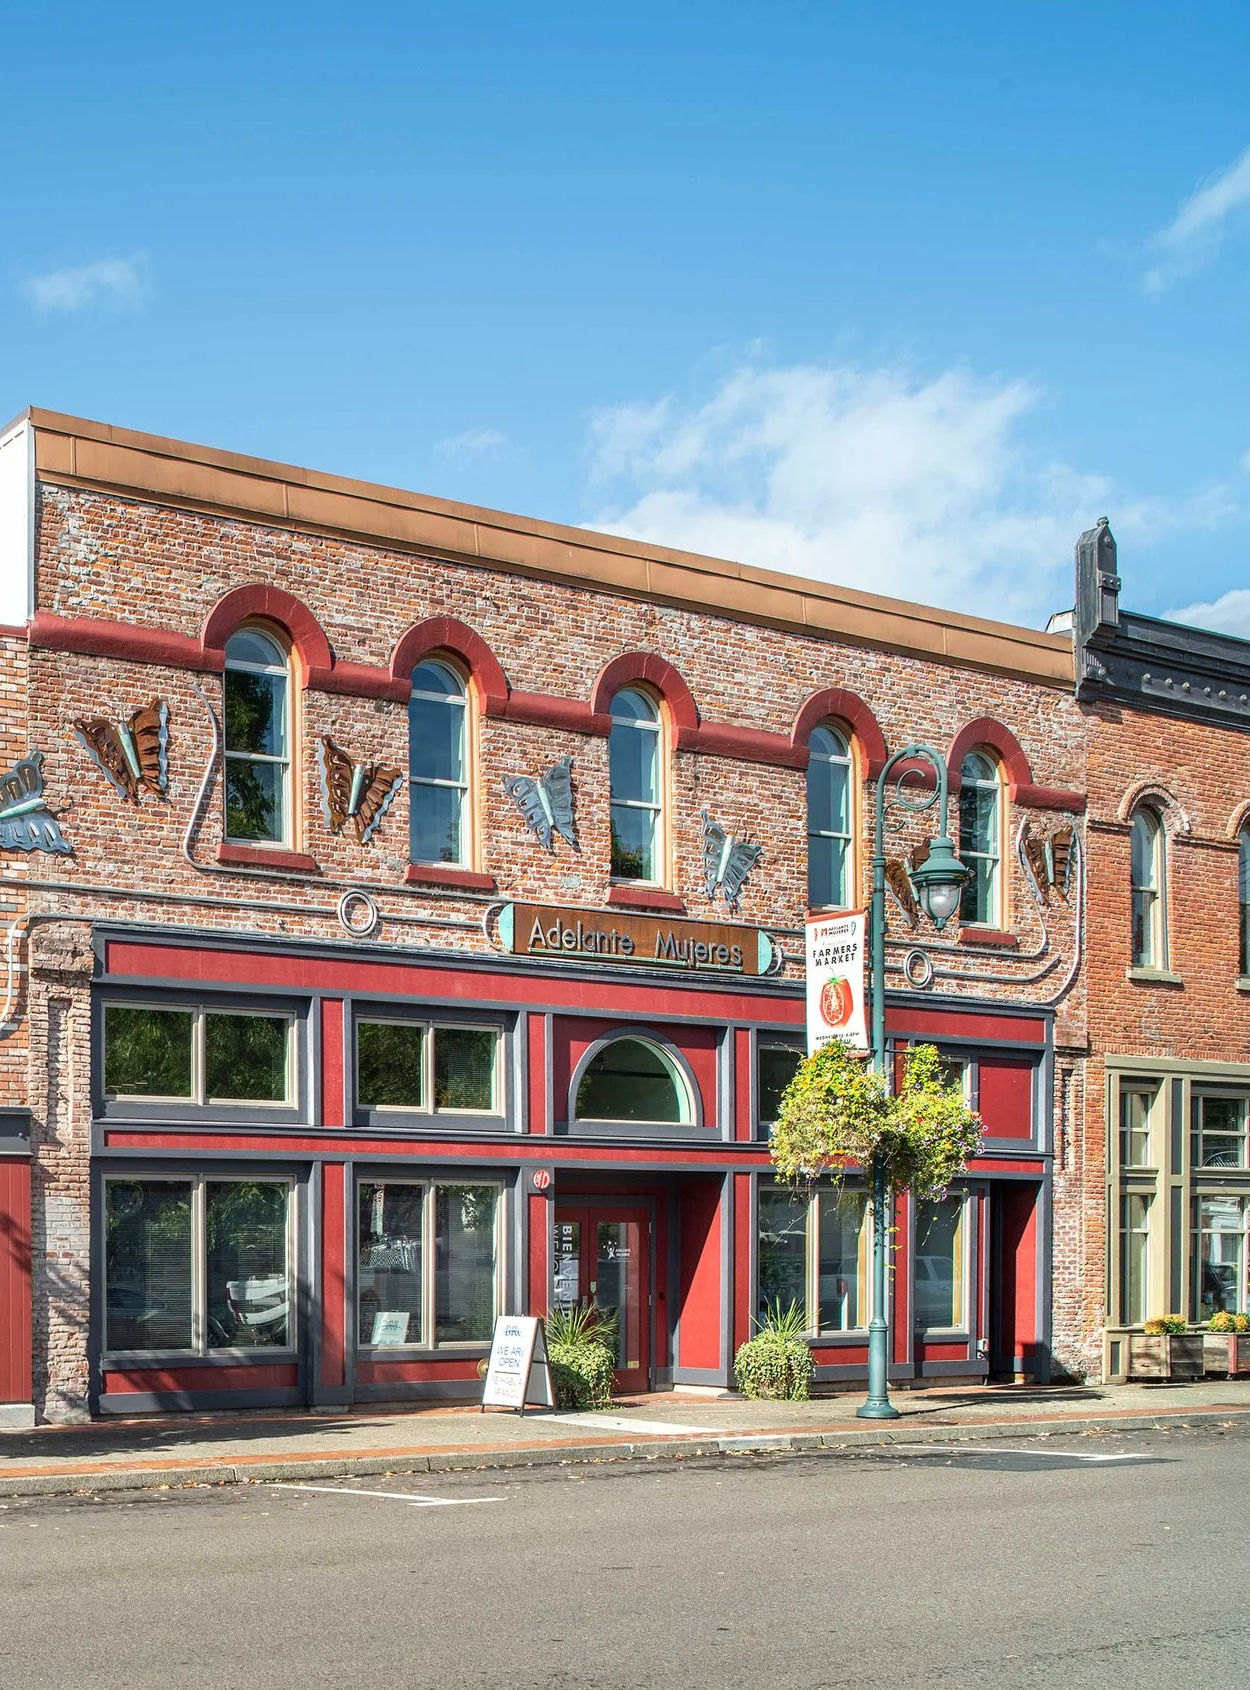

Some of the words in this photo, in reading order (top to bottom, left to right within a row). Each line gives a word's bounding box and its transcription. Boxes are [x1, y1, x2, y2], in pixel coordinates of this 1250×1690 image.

[528, 916, 635, 956] Adelante
[654, 928, 744, 969] Mujeres
[812, 943, 858, 958] FARMERS
[815, 952, 855, 967] MARKET
[497, 1346, 509, 1356] WE
[498, 1357, 521, 1368] OPEN
